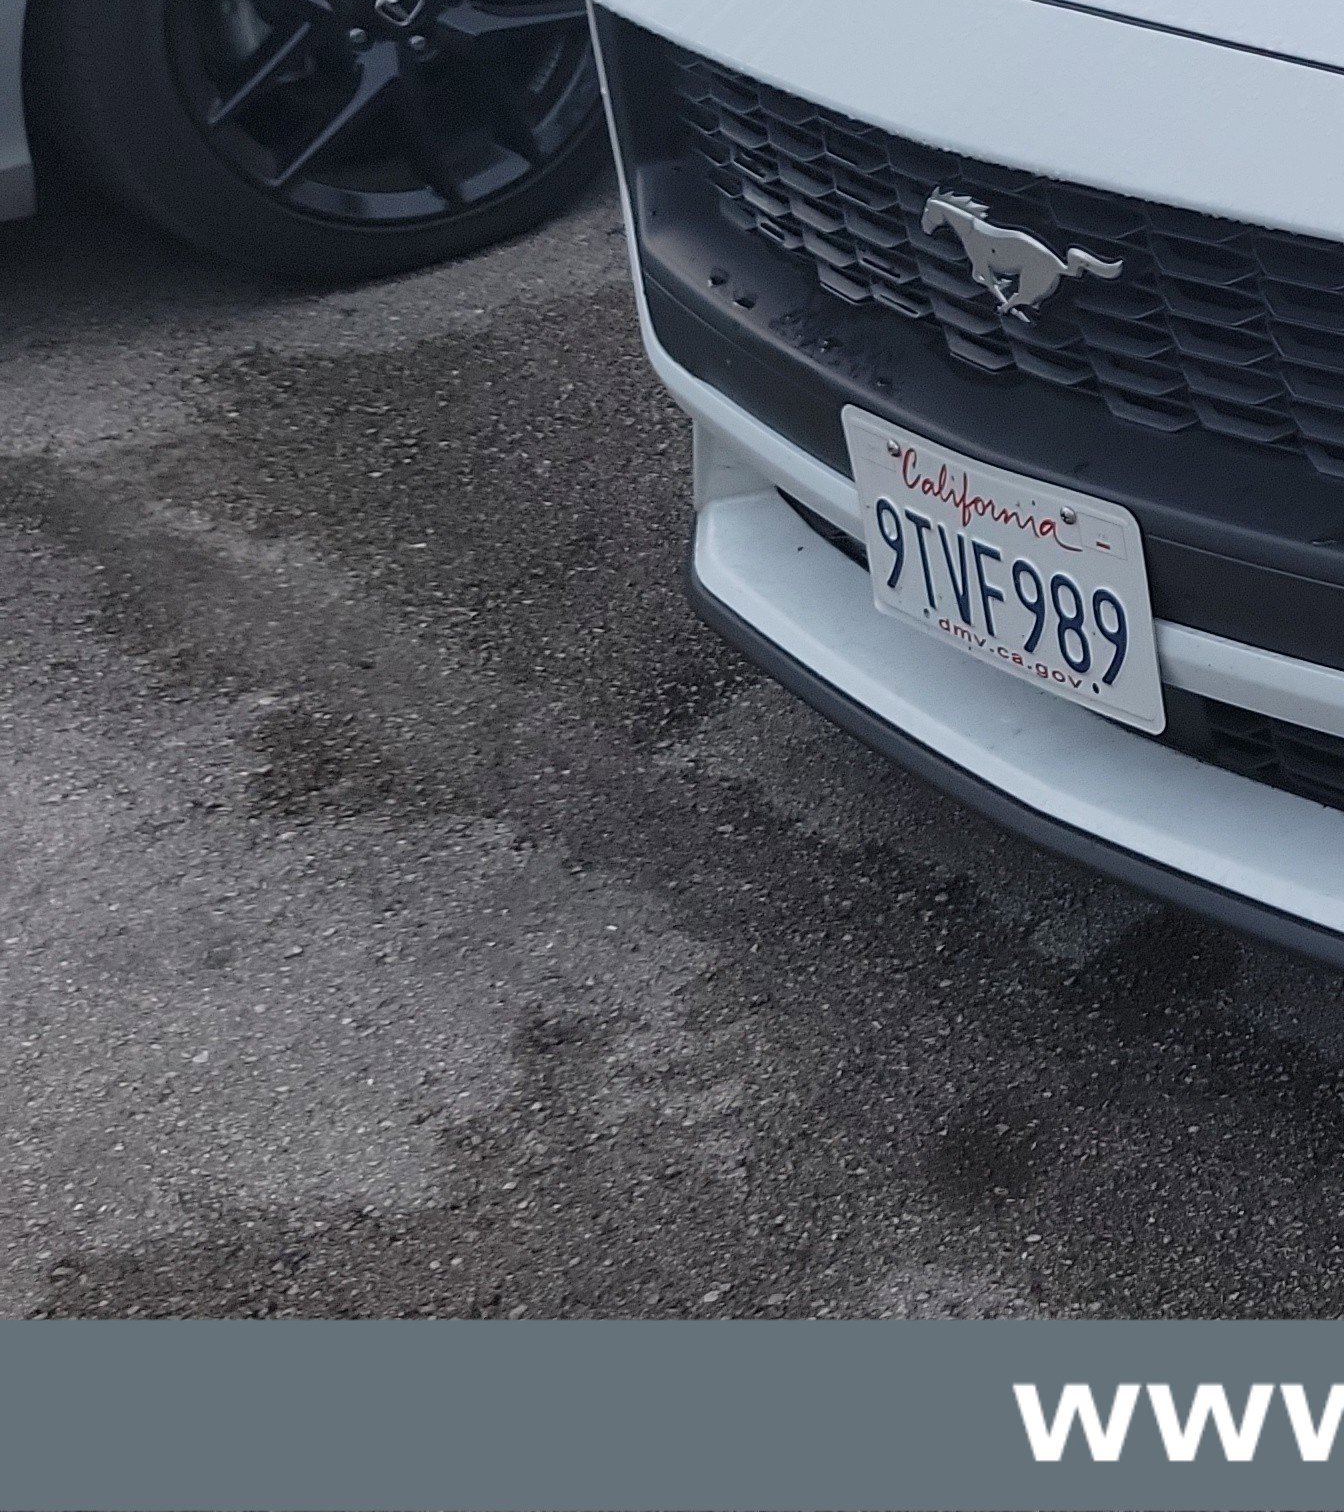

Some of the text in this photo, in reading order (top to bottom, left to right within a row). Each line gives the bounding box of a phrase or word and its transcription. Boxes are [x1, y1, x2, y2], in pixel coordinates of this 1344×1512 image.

[901, 447, 1084, 553] California
[876, 495, 1129, 687] 9TVF989
[938, 617, 1084, 690] dmv.ca.gov
